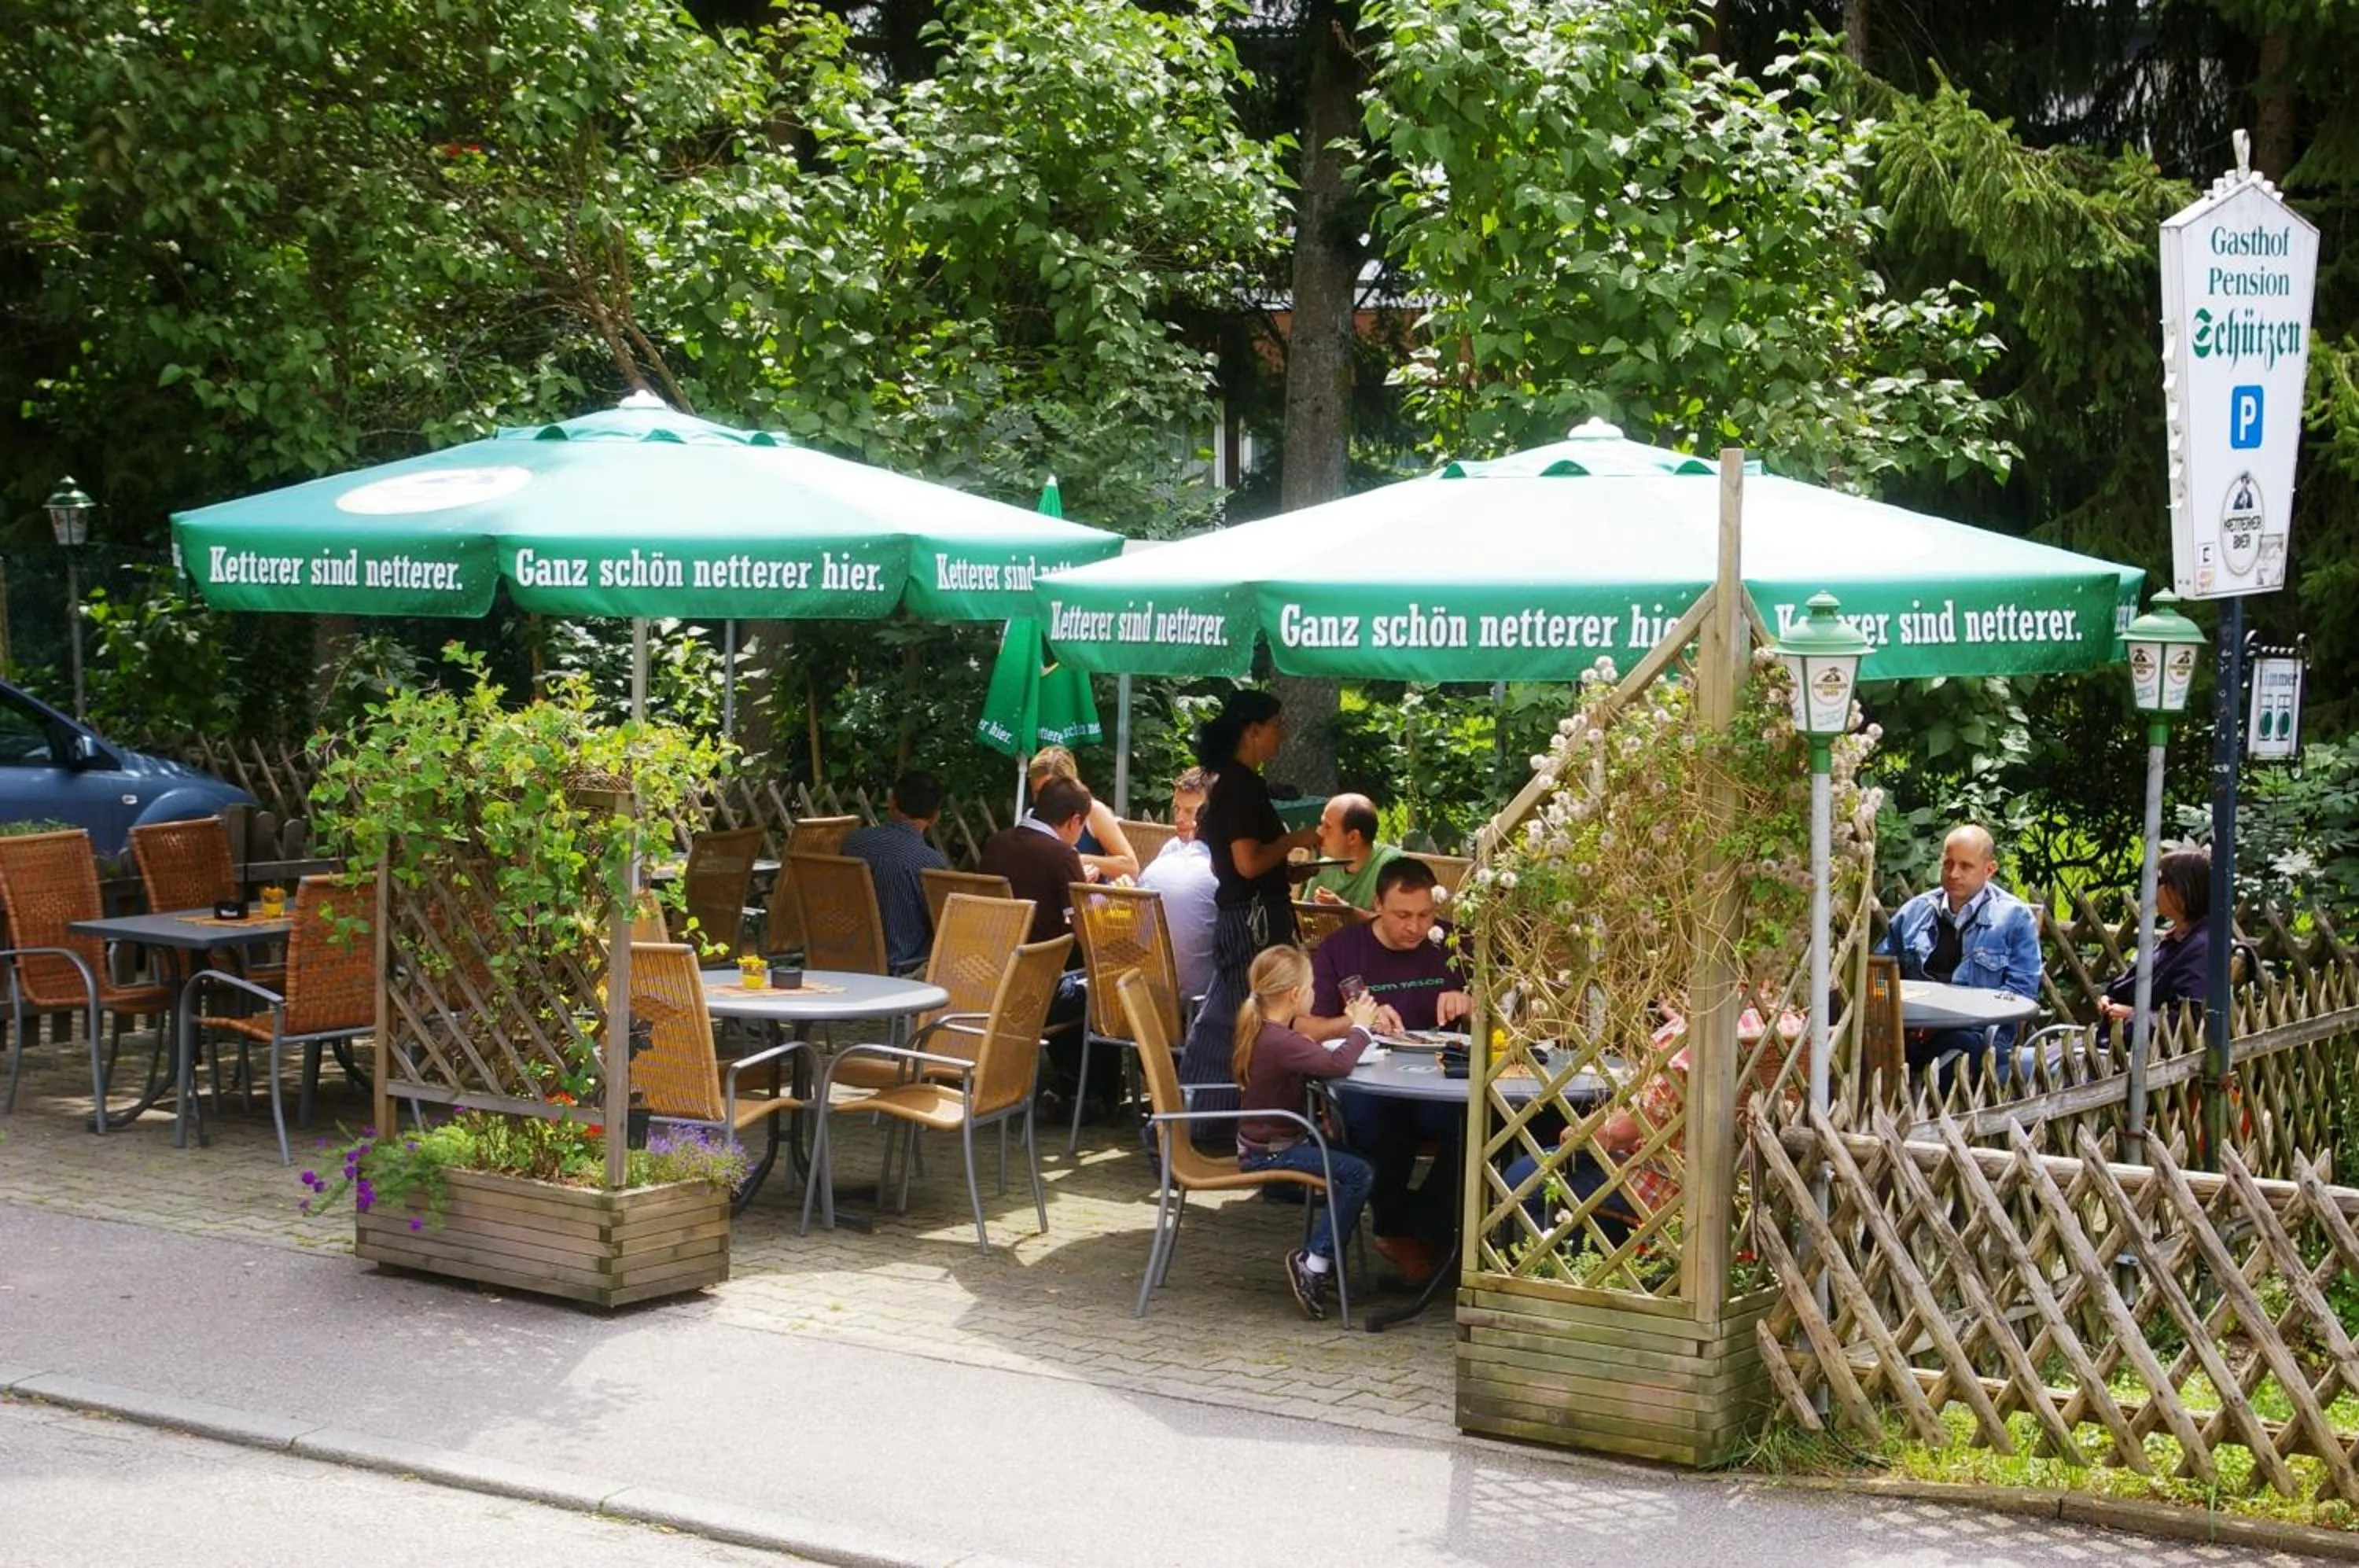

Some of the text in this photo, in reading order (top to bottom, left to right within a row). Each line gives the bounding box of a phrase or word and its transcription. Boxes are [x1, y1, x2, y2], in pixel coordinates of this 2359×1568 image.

[2210, 225, 2291, 256] Gasthof
[2208, 265, 2291, 296] Pension
[2192, 307, 2301, 373] Schützen
[2239, 395, 2258, 441] P
[209, 547, 304, 584] Ketterer
[311, 548, 358, 587] sind
[365, 554, 462, 591] netterer.
[515, 548, 885, 591] Ganz schön netterer hier.
[936, 553, 1000, 591] Ketterer
[1004, 554, 1035, 591] sind
[1050, 601, 1228, 646] Ketterer sind netterer.
[1280, 603, 1360, 647] Ganz
[1371, 603, 1468, 647] schön
[1478, 608, 1620, 647] netterer
[1898, 599, 1957, 644] sind
[1963, 603, 2082, 642] netterer.
